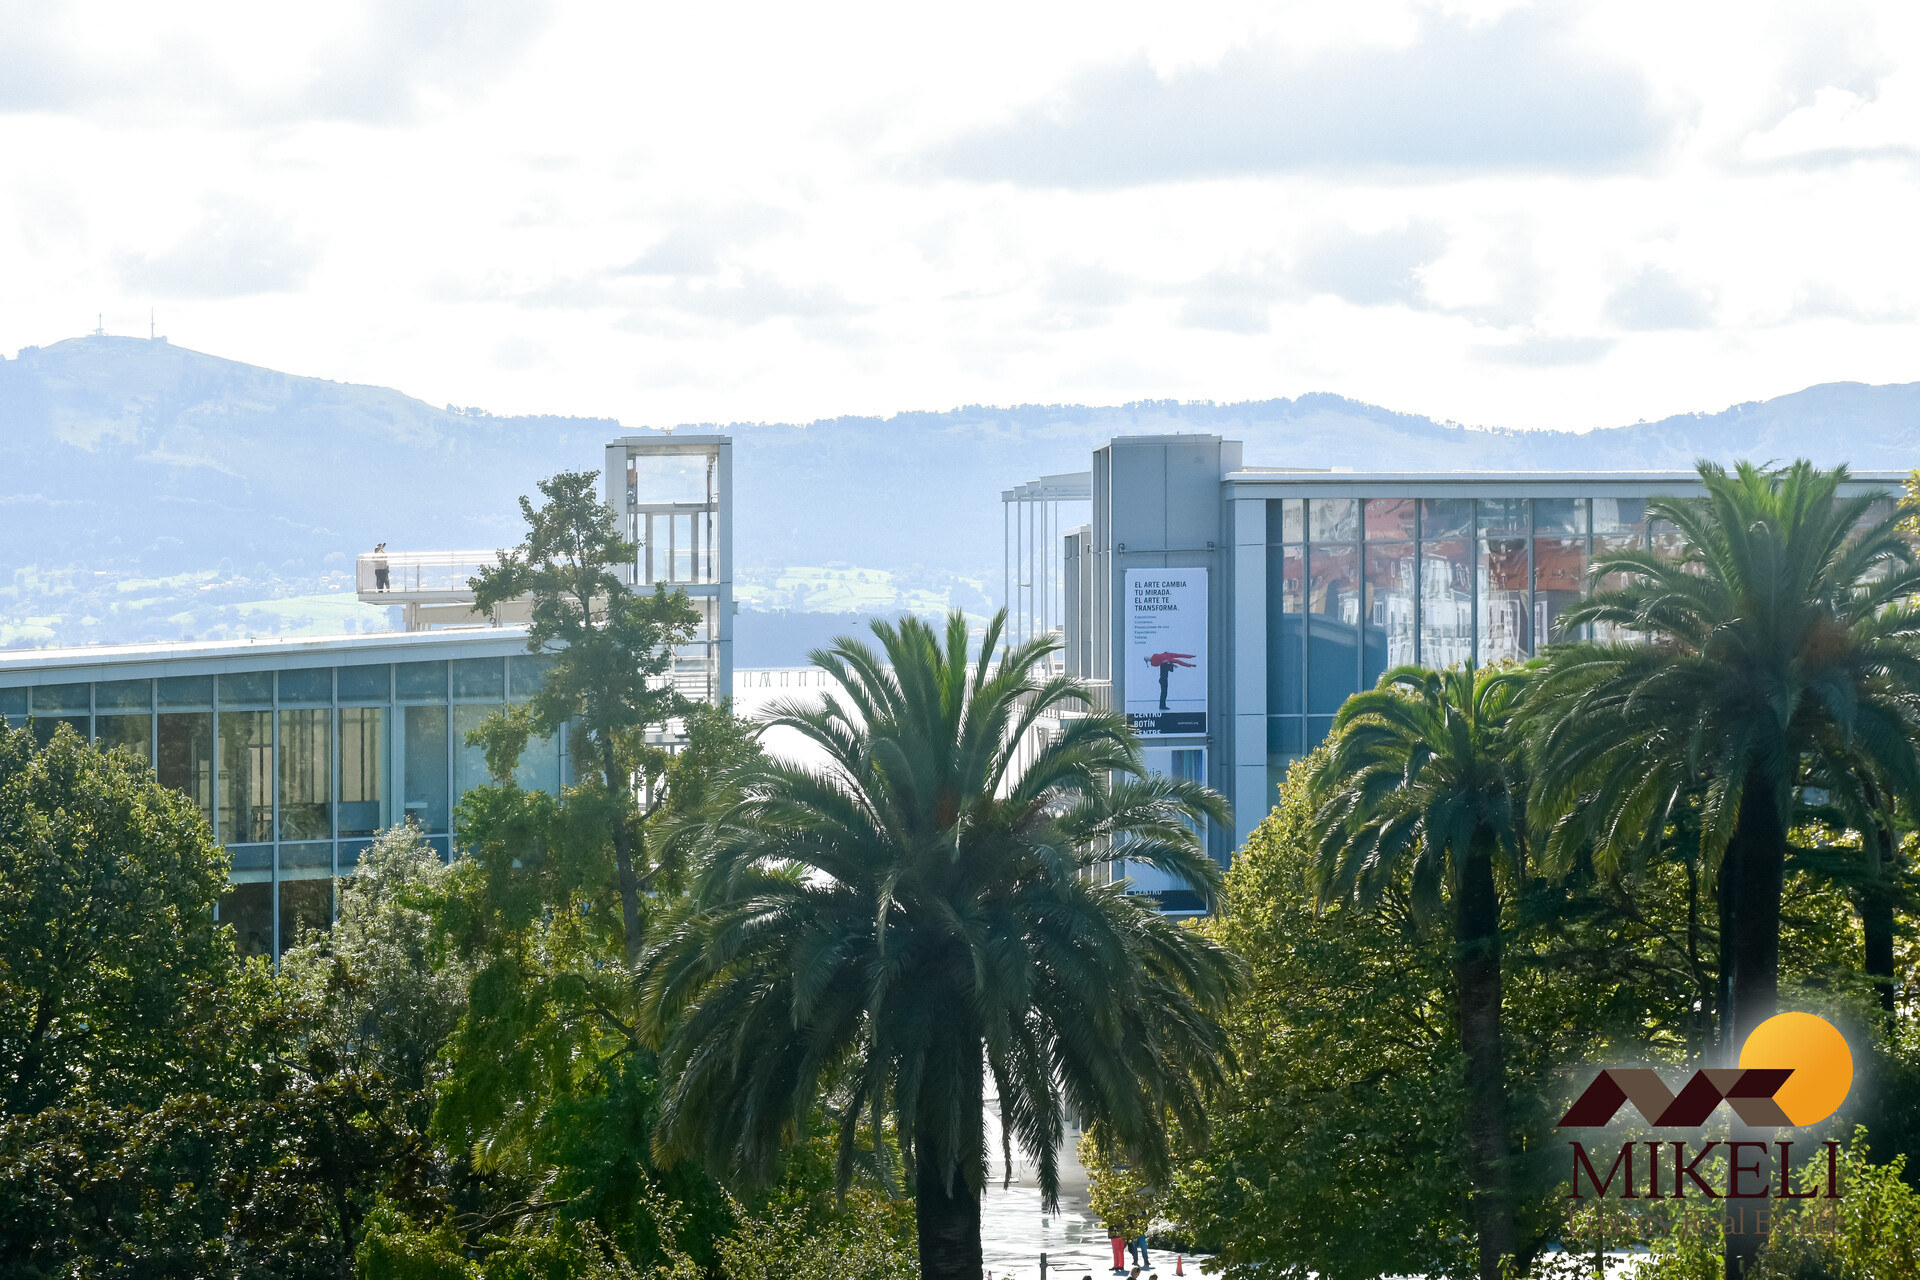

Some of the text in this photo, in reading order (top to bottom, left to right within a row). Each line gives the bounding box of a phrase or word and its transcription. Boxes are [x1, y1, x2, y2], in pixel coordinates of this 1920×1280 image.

[1161, 596, 1170, 604] TE
[1134, 604, 1180, 612] TRANSFORMA.
[1133, 719, 1156, 728] BOTÍN
